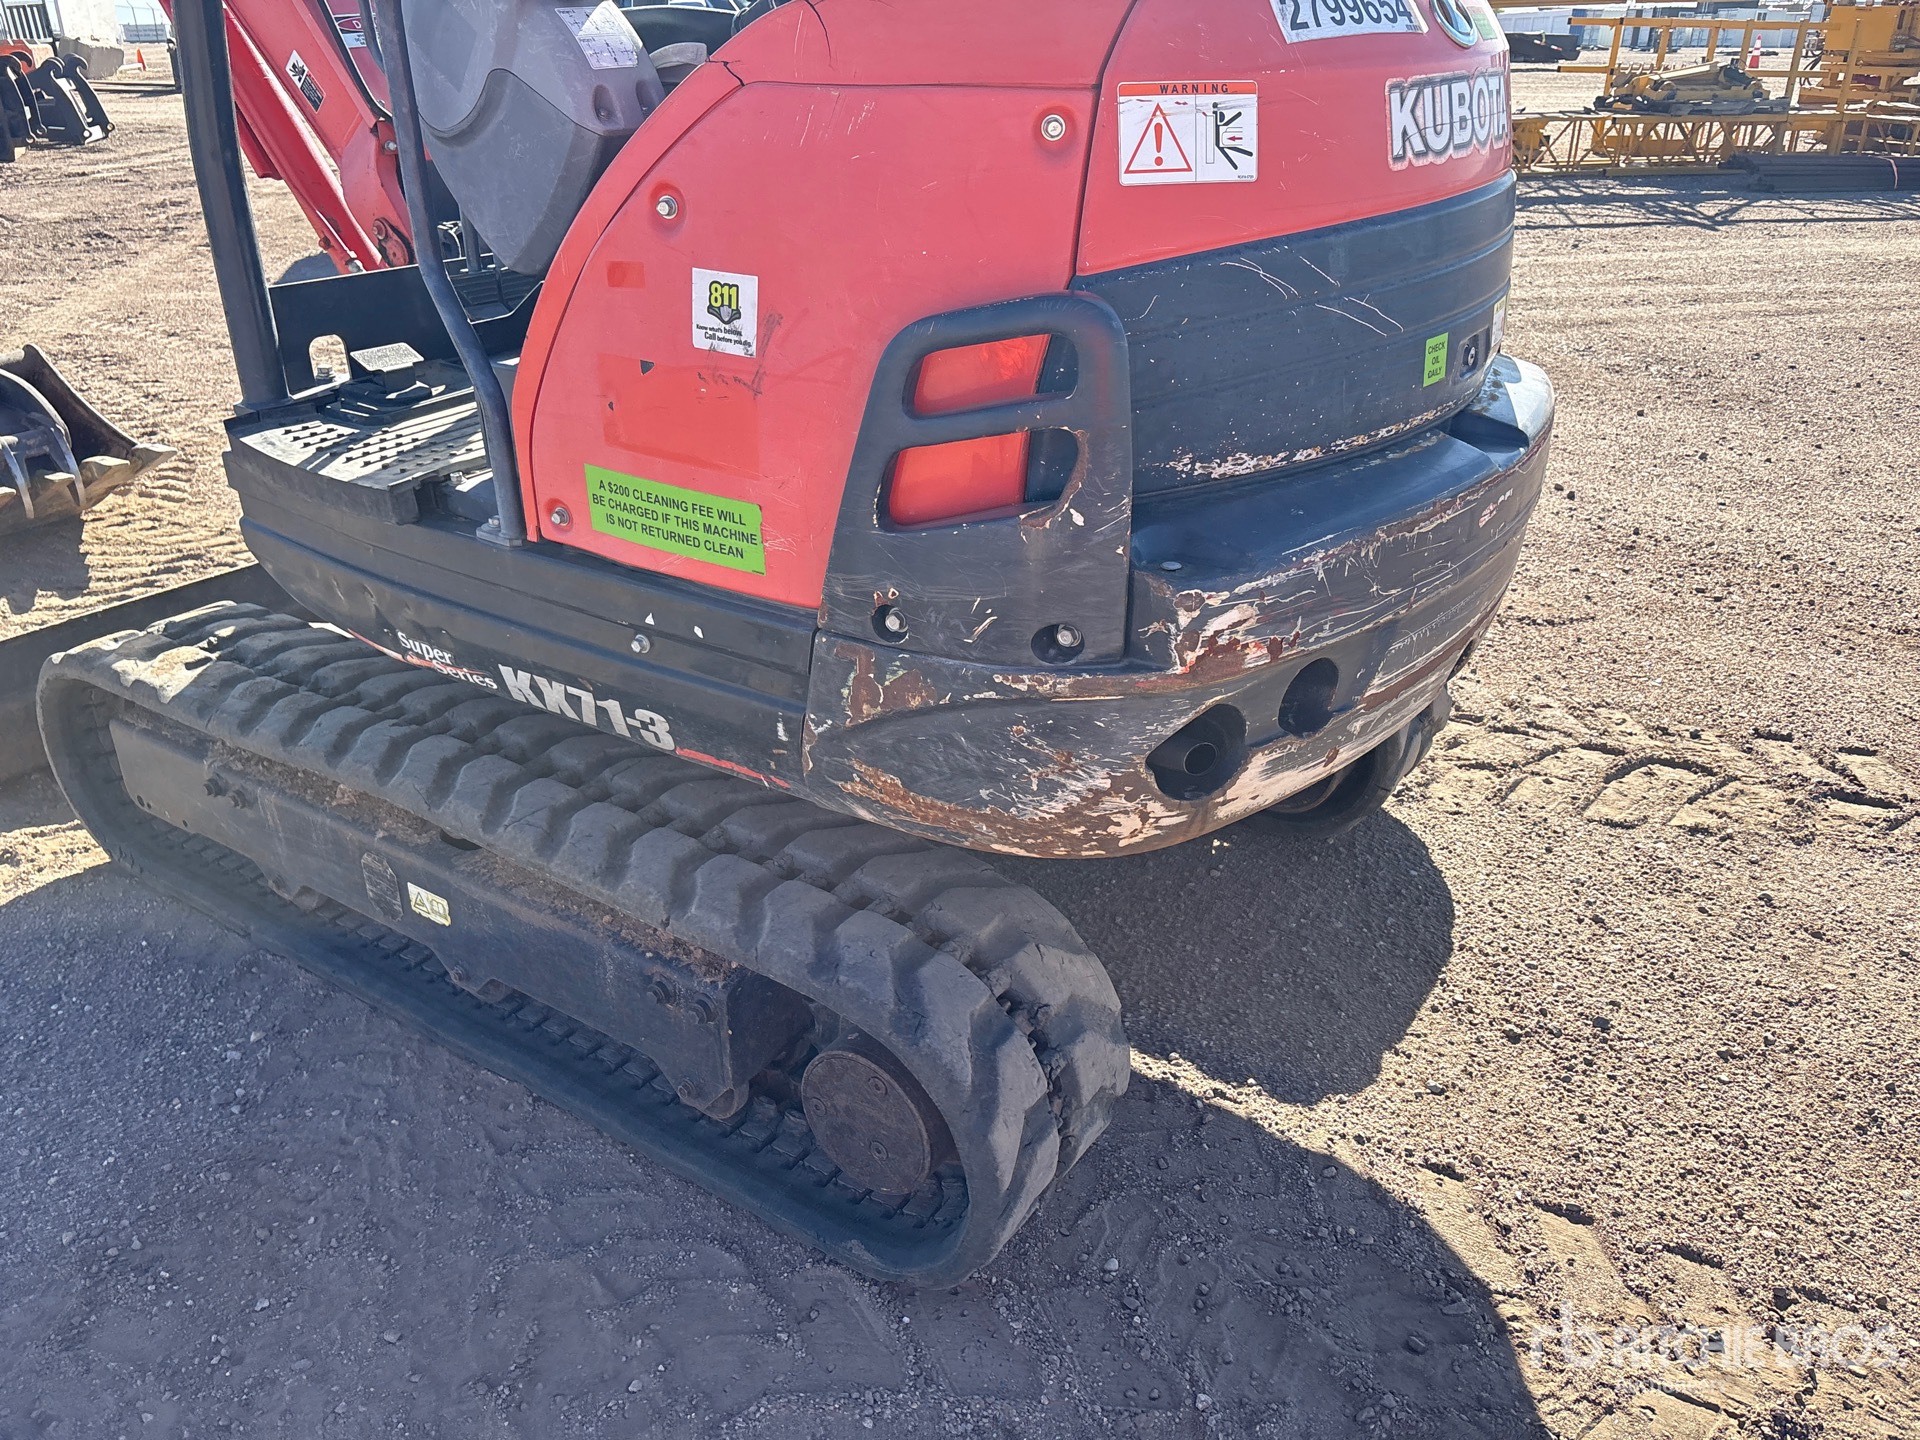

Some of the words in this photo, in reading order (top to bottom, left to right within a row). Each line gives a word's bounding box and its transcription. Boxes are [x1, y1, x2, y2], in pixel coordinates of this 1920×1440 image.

[1159, 83, 1229, 94] WARNING
[1388, 73, 1508, 160] KUBOTA
[708, 280, 739, 310] 811
[704, 331, 717, 341] Call
[717, 335, 733, 344] before
[1427, 341, 1446, 355] CHECK
[1427, 366, 1442, 379] DAILY
[1431, 355, 1440, 366] OIL
[599, 480, 606, 491] A
[608, 481, 630, 498] $200
[632, 490, 689, 512] CLEANING
[691, 503, 714, 519] FEE
[717, 508, 746, 526] WILL
[592, 493, 606, 506] BE
[608, 499, 659, 522] CHARGED
[661, 512, 671, 524] IF
[674, 515, 700, 532] THIS
[703, 522, 758, 546] MACHINE
[606, 513, 615, 525] IS
[617, 517, 638, 532] NOT
[641, 523, 700, 549] RETURNED
[703, 540, 744, 559] CLEAN
[397, 630, 453, 665] Super
[432, 659, 498, 690] Series
[498, 663, 676, 751] KX71-3
